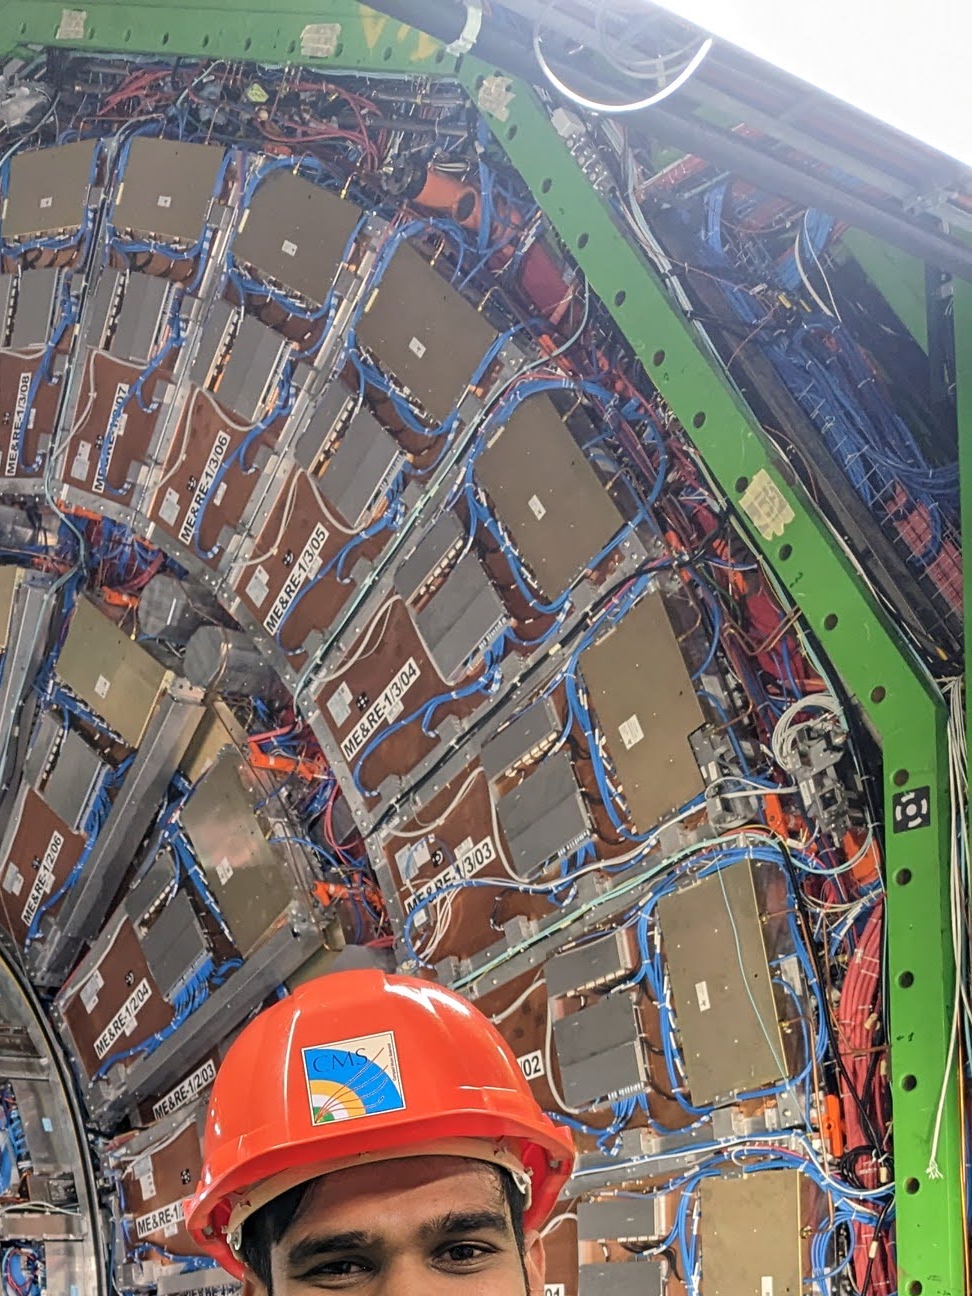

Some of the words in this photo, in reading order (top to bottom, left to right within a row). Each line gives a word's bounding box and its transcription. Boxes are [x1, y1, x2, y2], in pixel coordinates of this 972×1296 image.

[7, 375, 31, 475] ME&RE-1/3/08
[181, 435, 228, 542] ME&RE-1/3/06
[265, 528, 327, 632] ME&RE-1/3/05
[343, 662, 417, 758] ME&RE-1/3/04
[23, 835, 63, 923] ME&RE-1/2/06
[95, 983, 150, 1057] ME&RE-1/2/04
[313, 1047, 368, 1073] CMS
[154, 1066, 216, 1120] ME&RE-1/2/03
